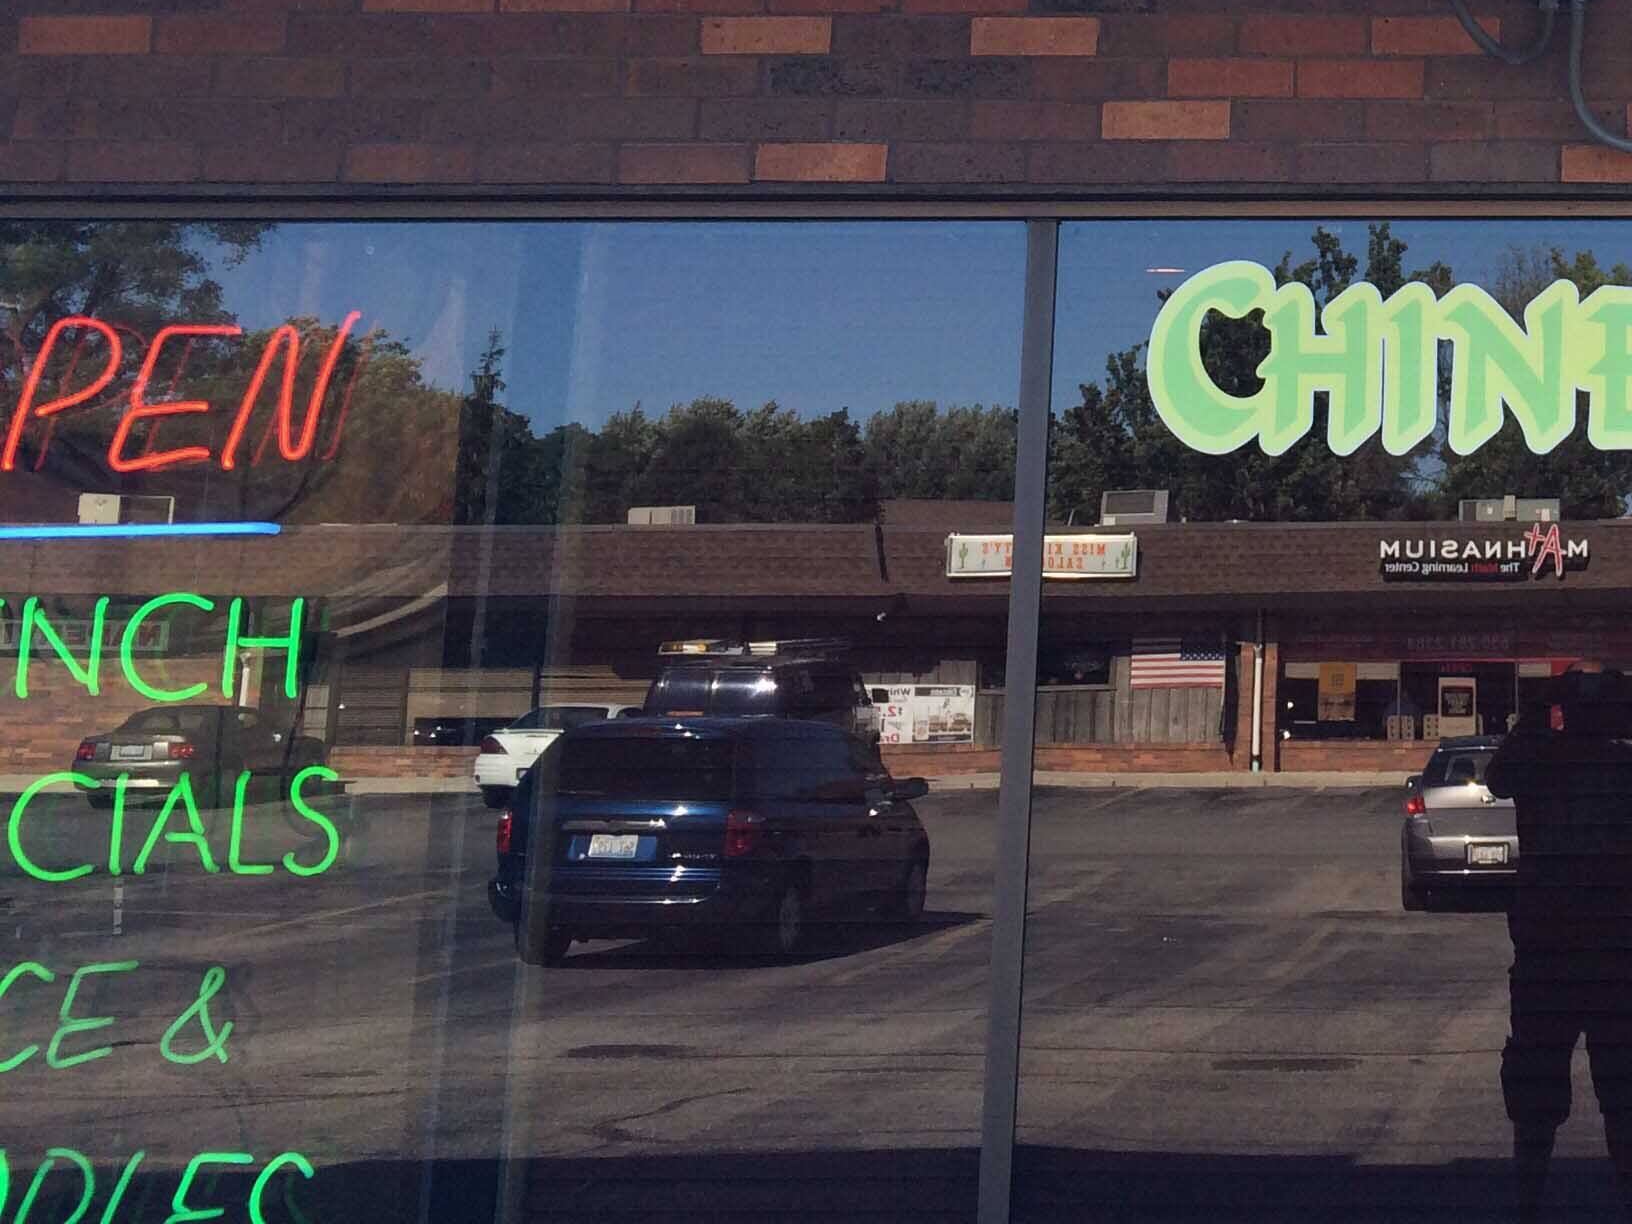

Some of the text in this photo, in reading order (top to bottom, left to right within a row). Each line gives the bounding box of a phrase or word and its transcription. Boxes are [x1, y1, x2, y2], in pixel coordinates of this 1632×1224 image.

[1, 310, 362, 473] PEN
[0, 592, 304, 702] NCH
[8, 766, 340, 882] CIALS
[160, 965, 235, 1065] &
[0, 1147, 314, 1224] DLES
